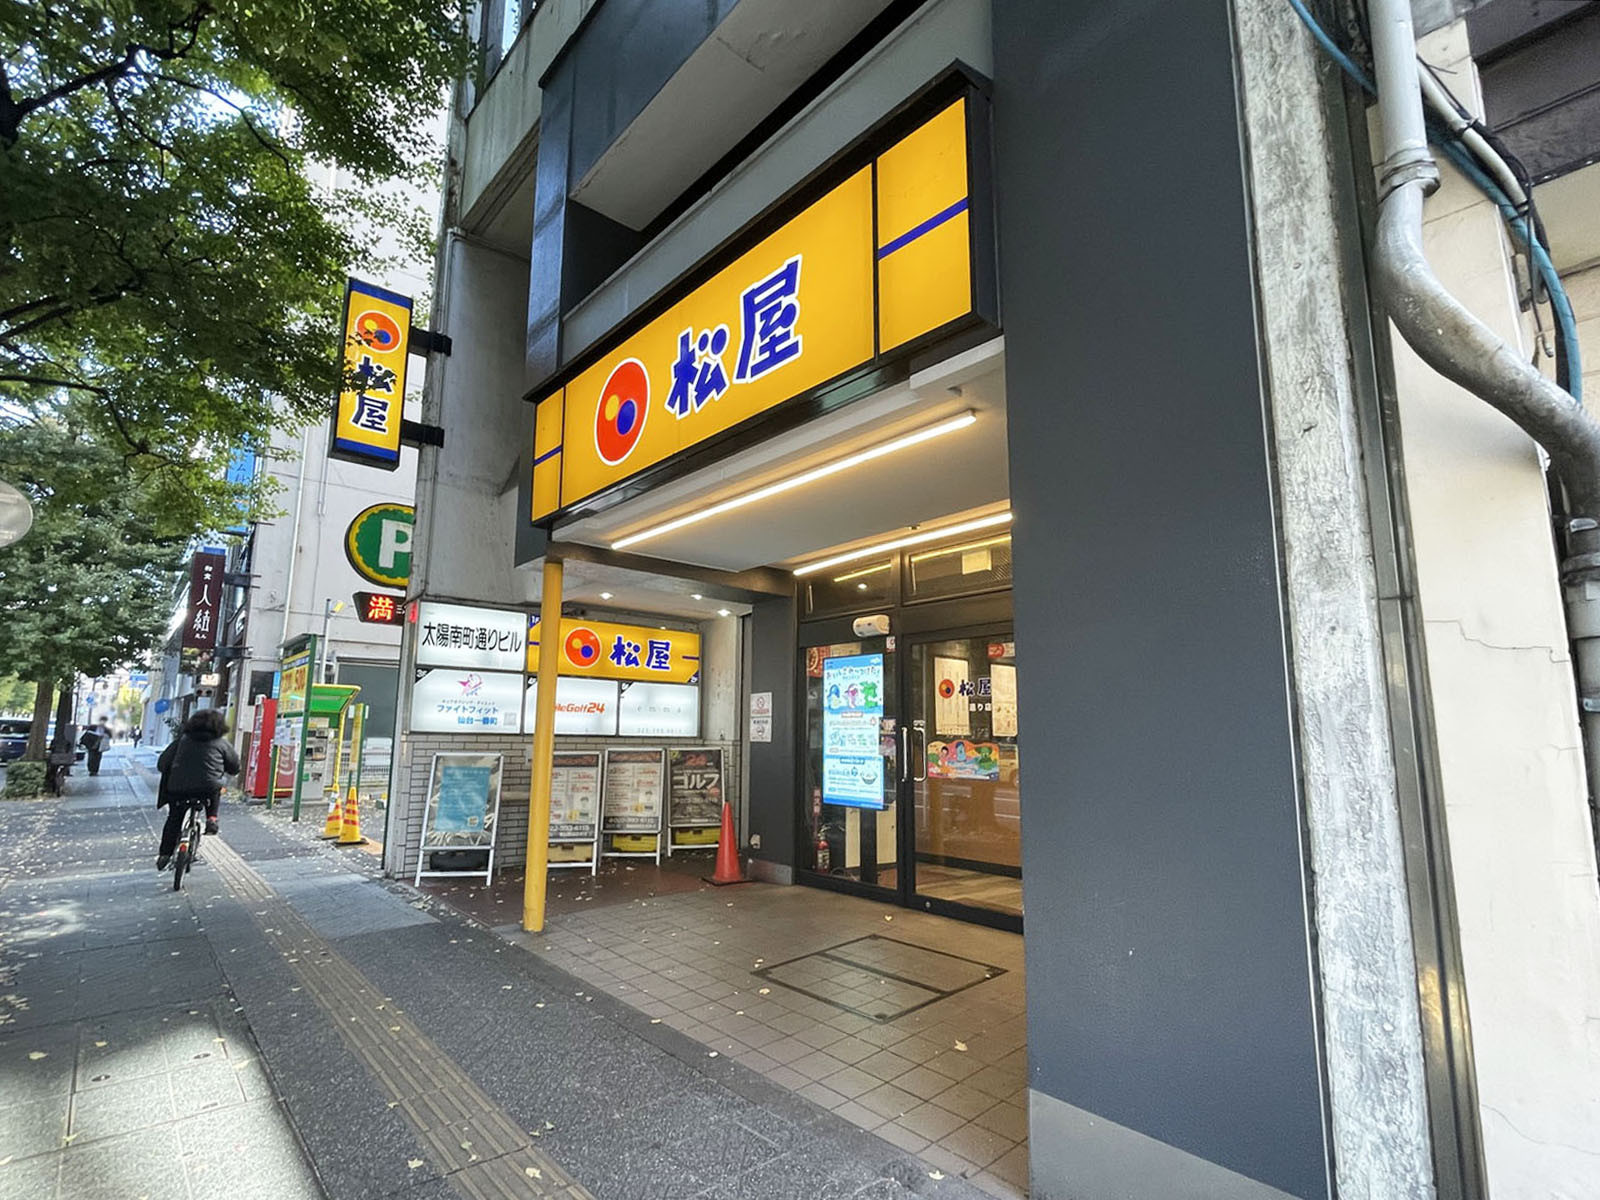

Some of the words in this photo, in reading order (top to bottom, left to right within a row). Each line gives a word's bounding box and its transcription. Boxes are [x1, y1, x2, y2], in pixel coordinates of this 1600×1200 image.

[665, 254, 802, 419] 松屋
[350, 355, 397, 434] 松屋
[378, 519, 413, 568] P
[368, 596, 394, 620] 満
[422, 621, 522, 653] 太陽南町通りビル
[609, 635, 672, 671] 松屋
[958, 677, 992, 698] 松屋
[436, 704, 499, 715] ファイトフィット
[672, 772, 720, 790] ゴルフ
